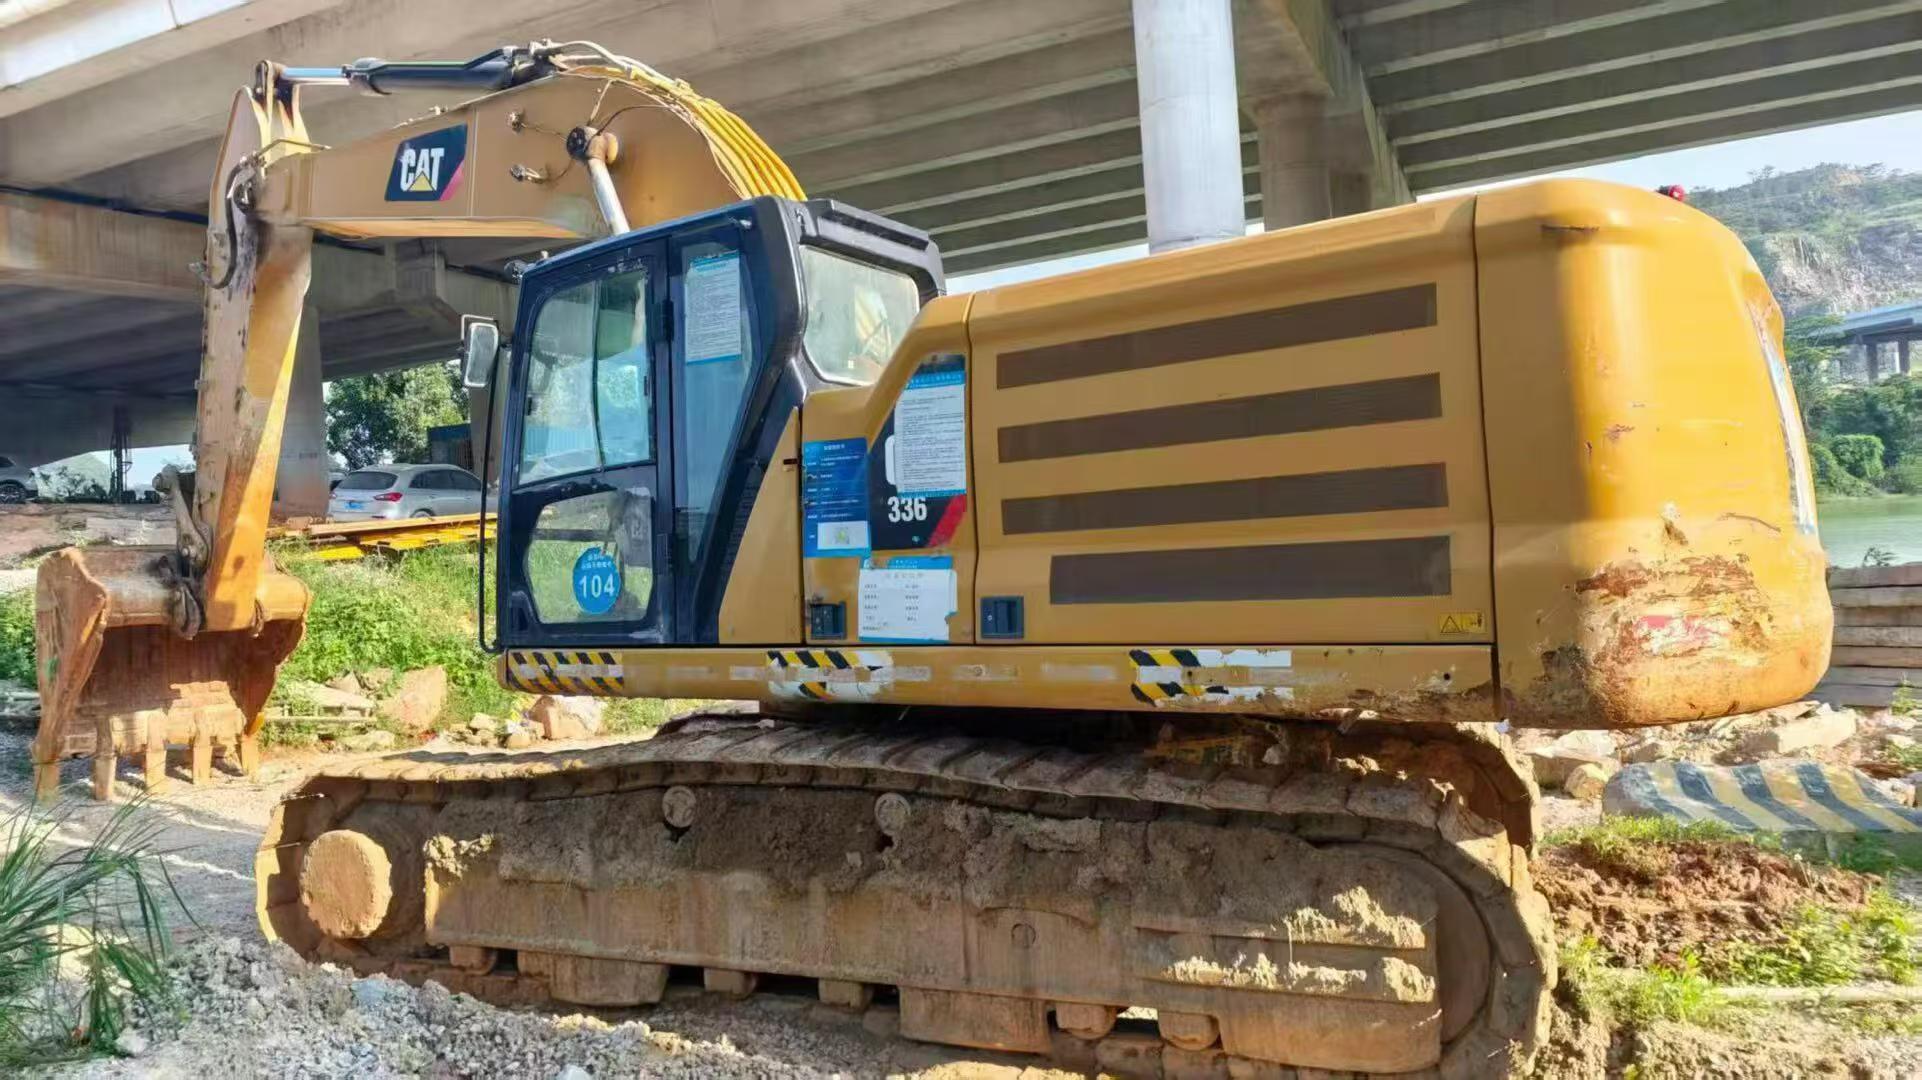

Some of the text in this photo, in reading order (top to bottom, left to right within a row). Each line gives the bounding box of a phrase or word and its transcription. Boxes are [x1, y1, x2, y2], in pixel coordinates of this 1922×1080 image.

[399, 147, 445, 192] CAT
[887, 495, 928, 523] 336
[579, 573, 616, 599] 104
